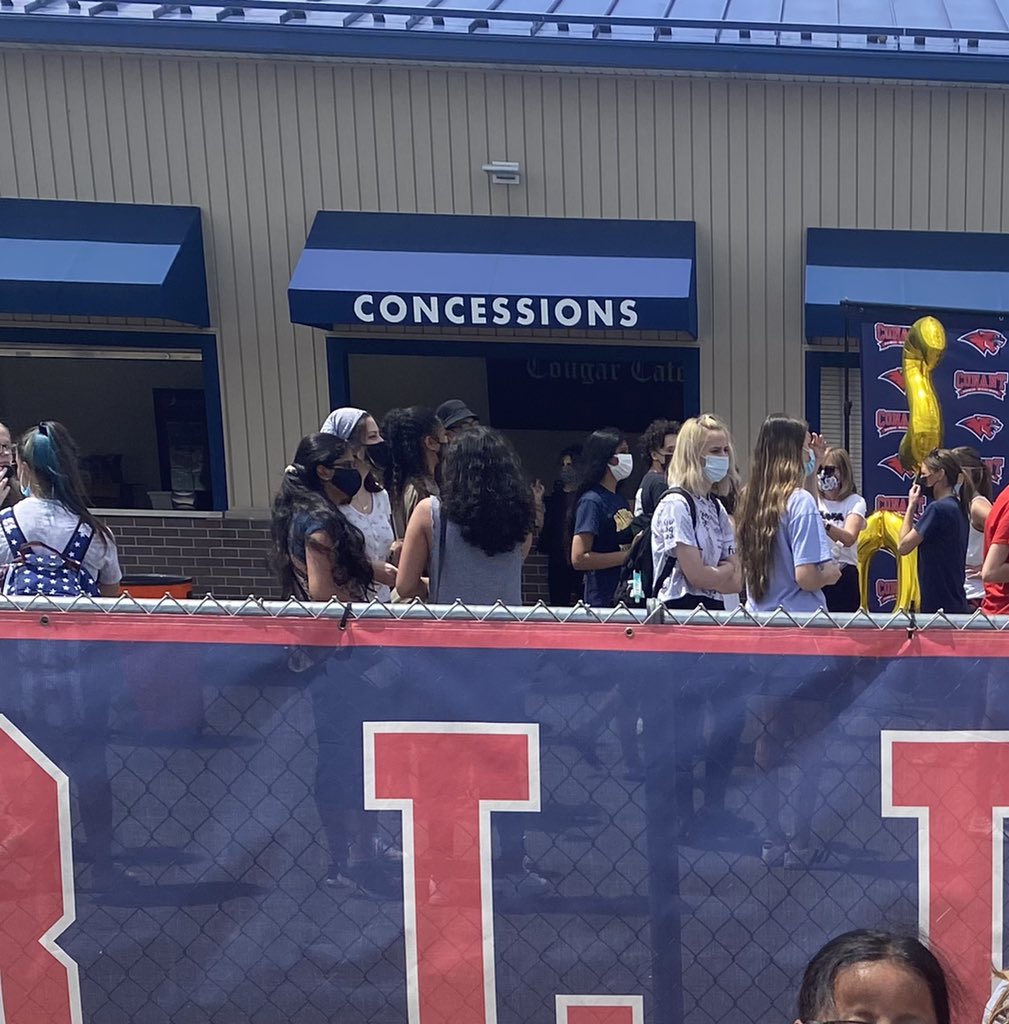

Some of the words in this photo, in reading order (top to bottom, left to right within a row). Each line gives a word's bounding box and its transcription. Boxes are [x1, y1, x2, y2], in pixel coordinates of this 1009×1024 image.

[353, 294, 638, 327] CONCESSIONS
[874, 322, 912, 343] CONA
[526, 358, 621, 385] Cougar
[954, 370, 1009, 391] CONANT
[876, 409, 910, 429] CONA
